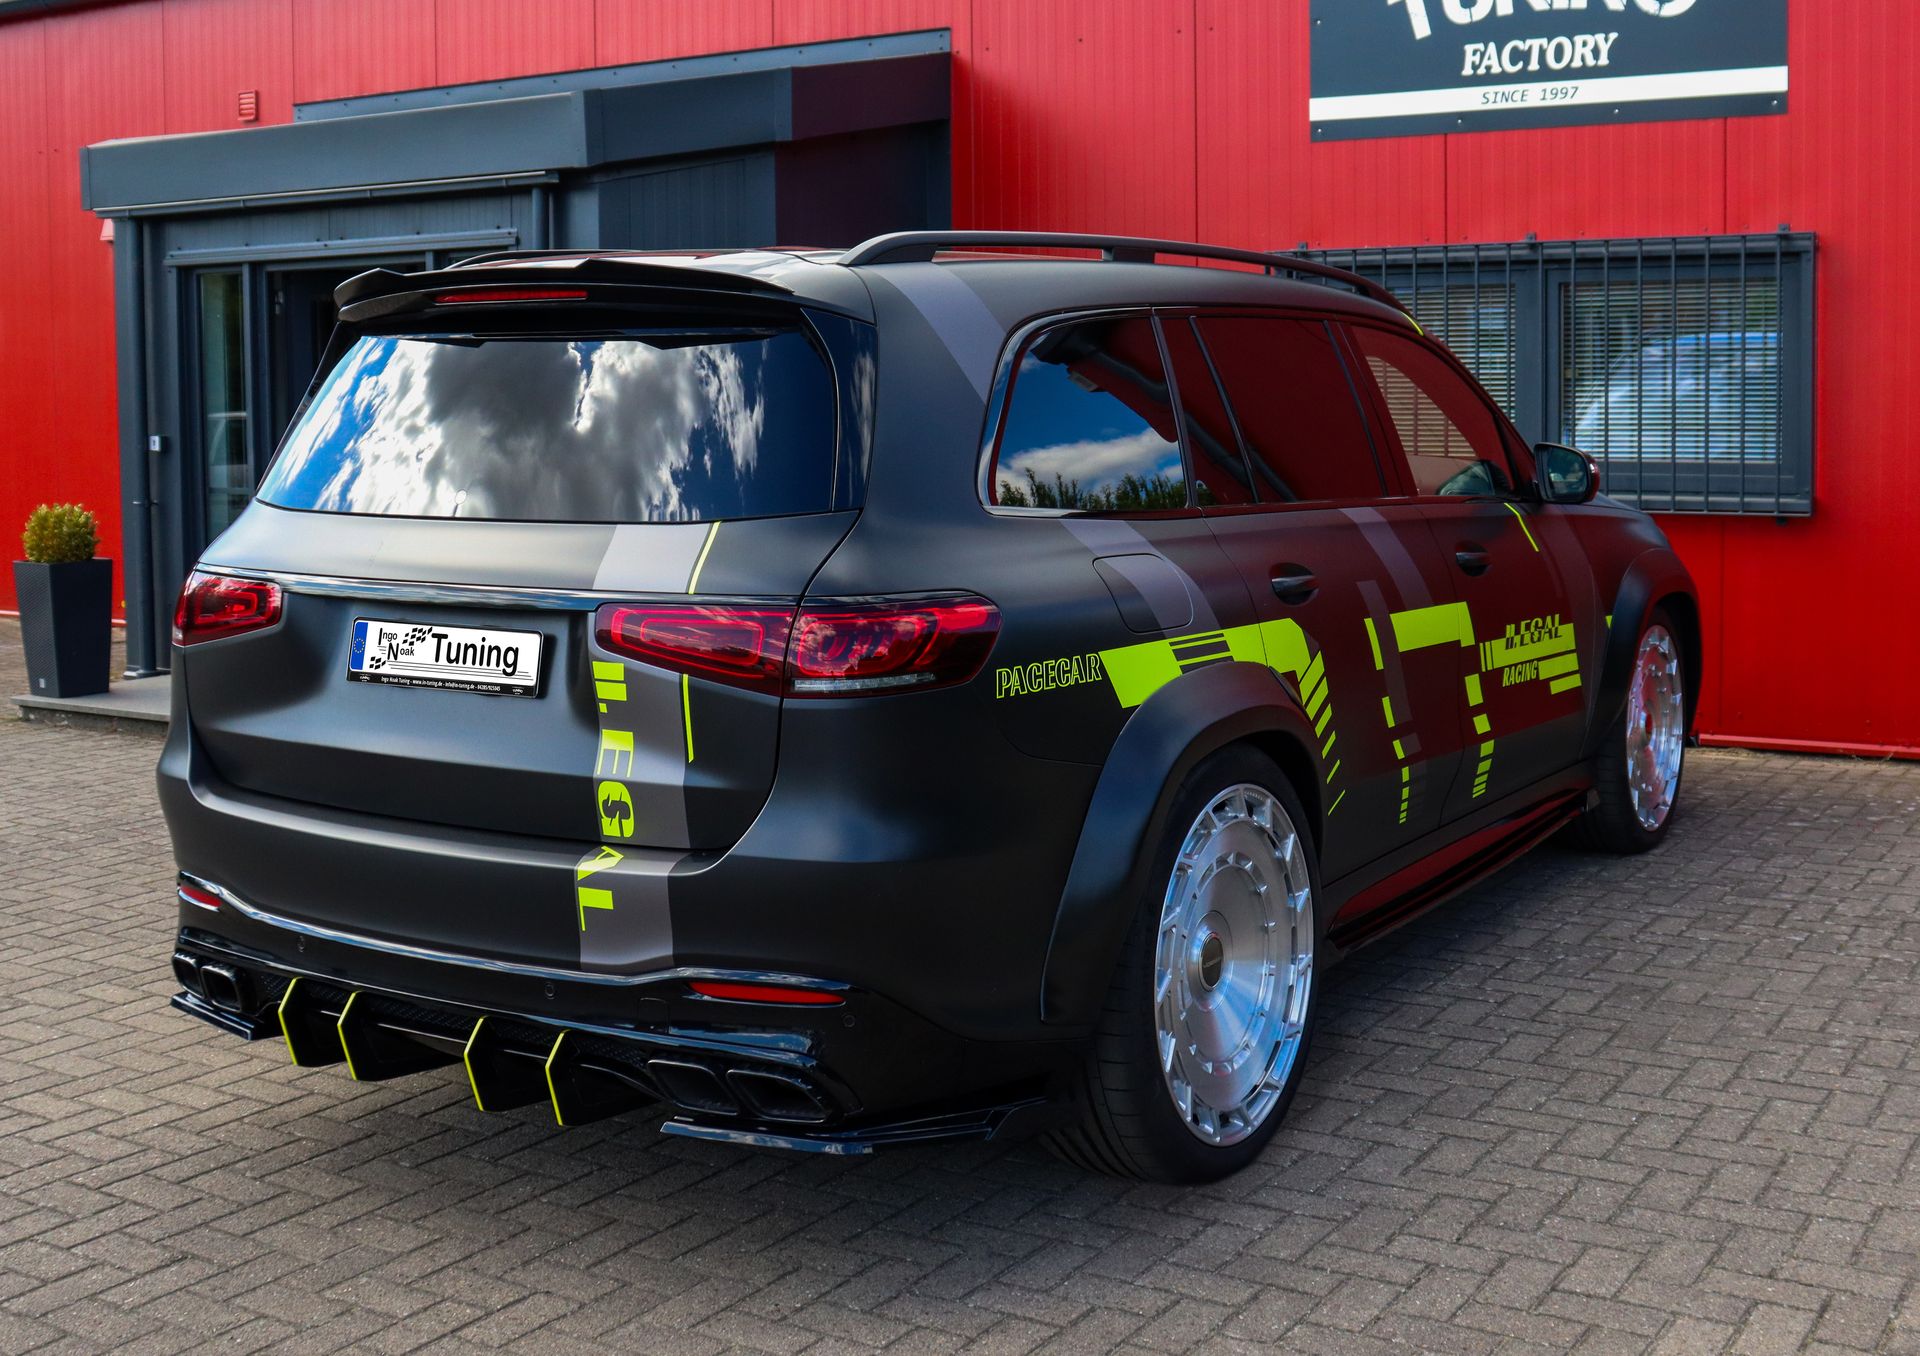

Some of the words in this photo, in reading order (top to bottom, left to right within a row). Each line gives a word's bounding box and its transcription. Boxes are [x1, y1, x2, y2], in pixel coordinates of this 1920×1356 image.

[1461, 32, 1619, 77] FACTORY
[1481, 89, 1528, 105] SINCE
[1540, 86, 1579, 101] 1997
[378, 627, 398, 645] Ingo
[387, 643, 415, 661] Noak
[431, 633, 519, 677] Tuning
[996, 653, 1102, 699] PACECAR
[1502, 660, 1538, 688] RACING
